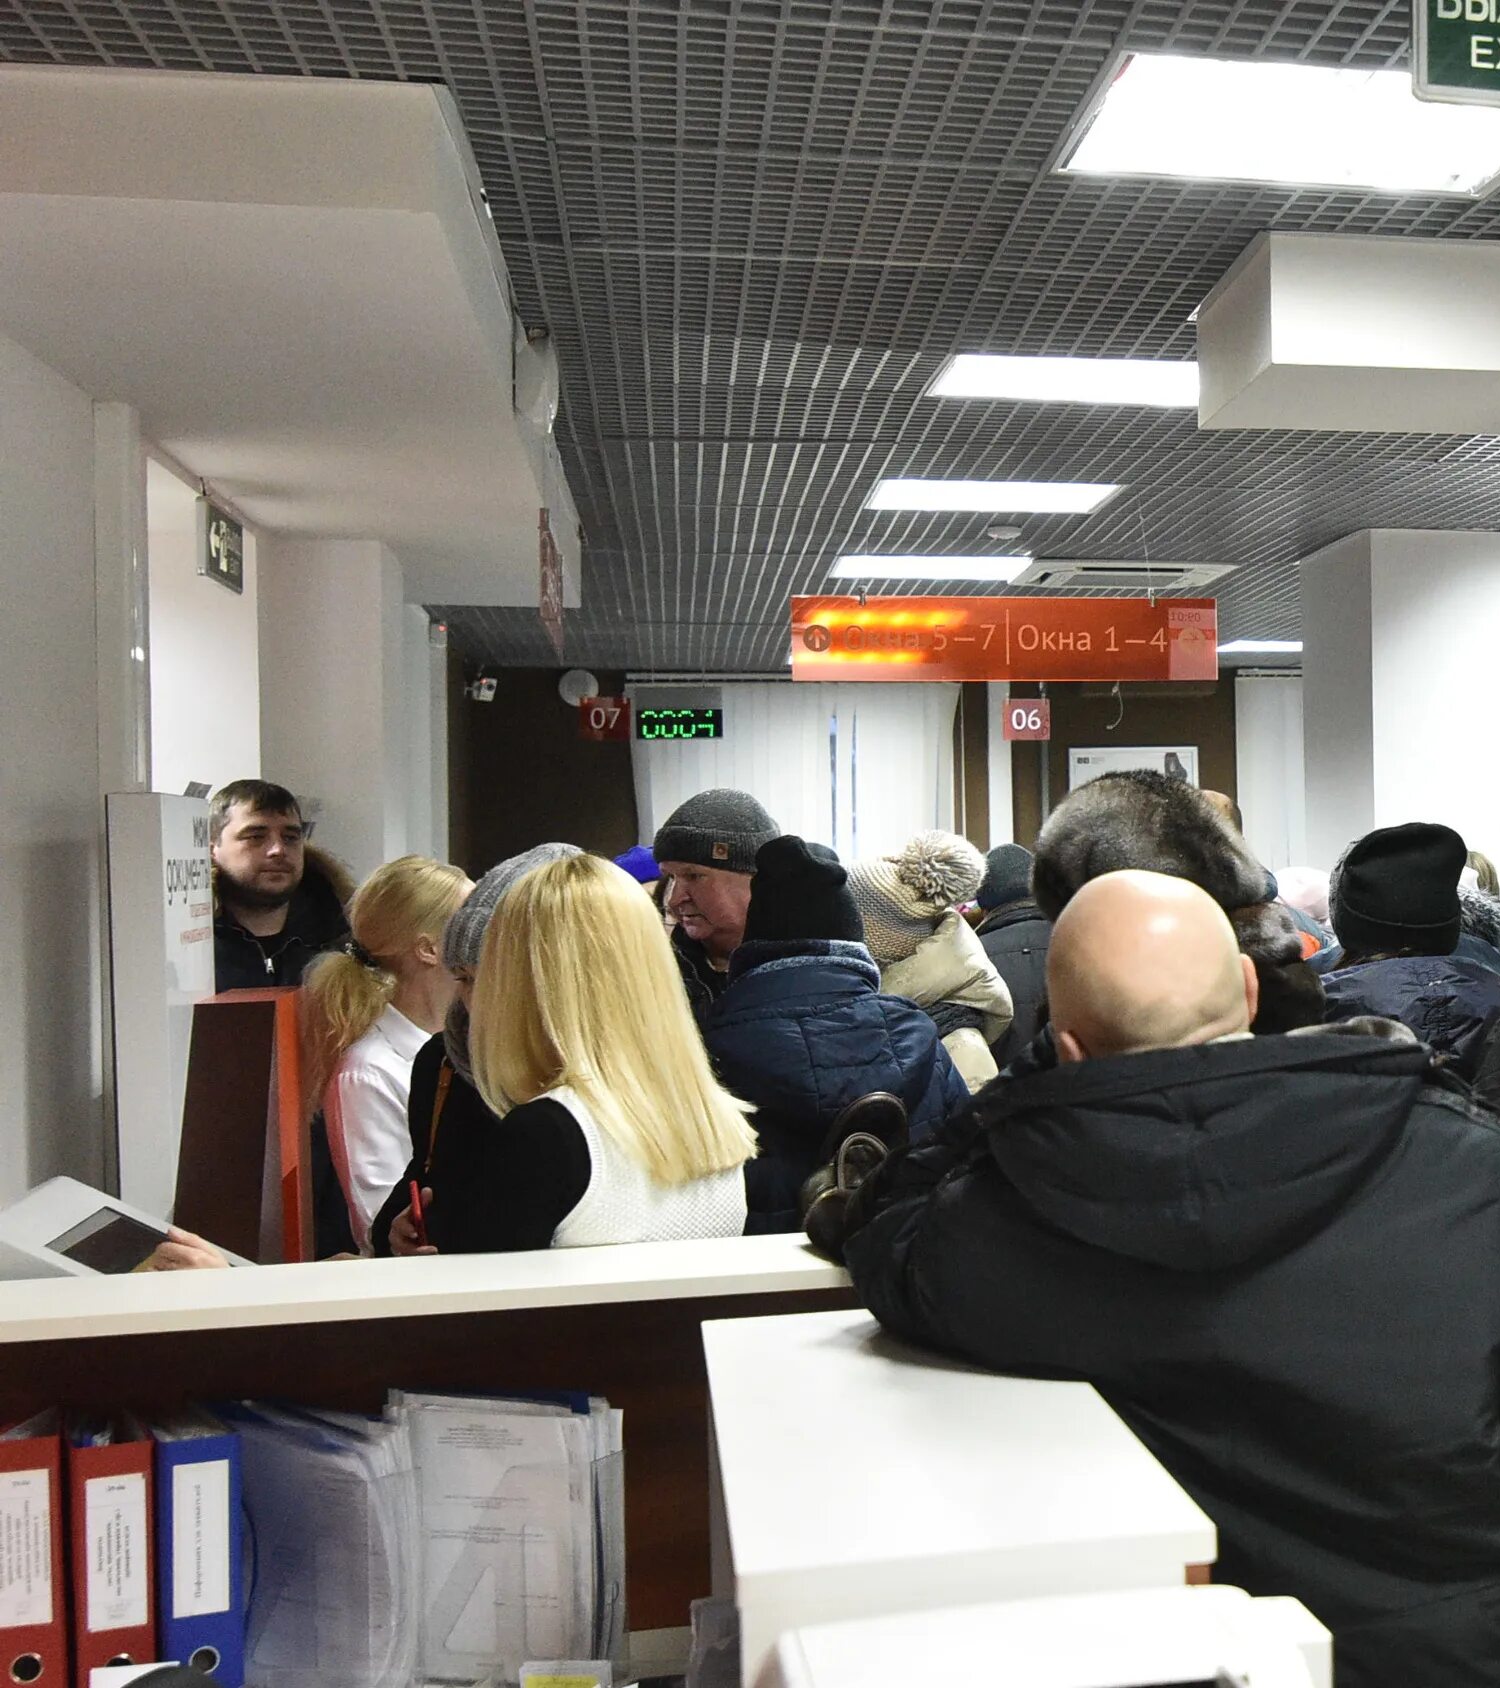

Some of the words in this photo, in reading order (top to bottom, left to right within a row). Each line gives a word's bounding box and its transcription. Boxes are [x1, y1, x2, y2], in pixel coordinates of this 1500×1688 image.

[844, 625, 920, 650] Окна
[1017, 624, 1092, 651] Окна
[590, 707, 621, 729] 07
[1011, 708, 1042, 730] 06
